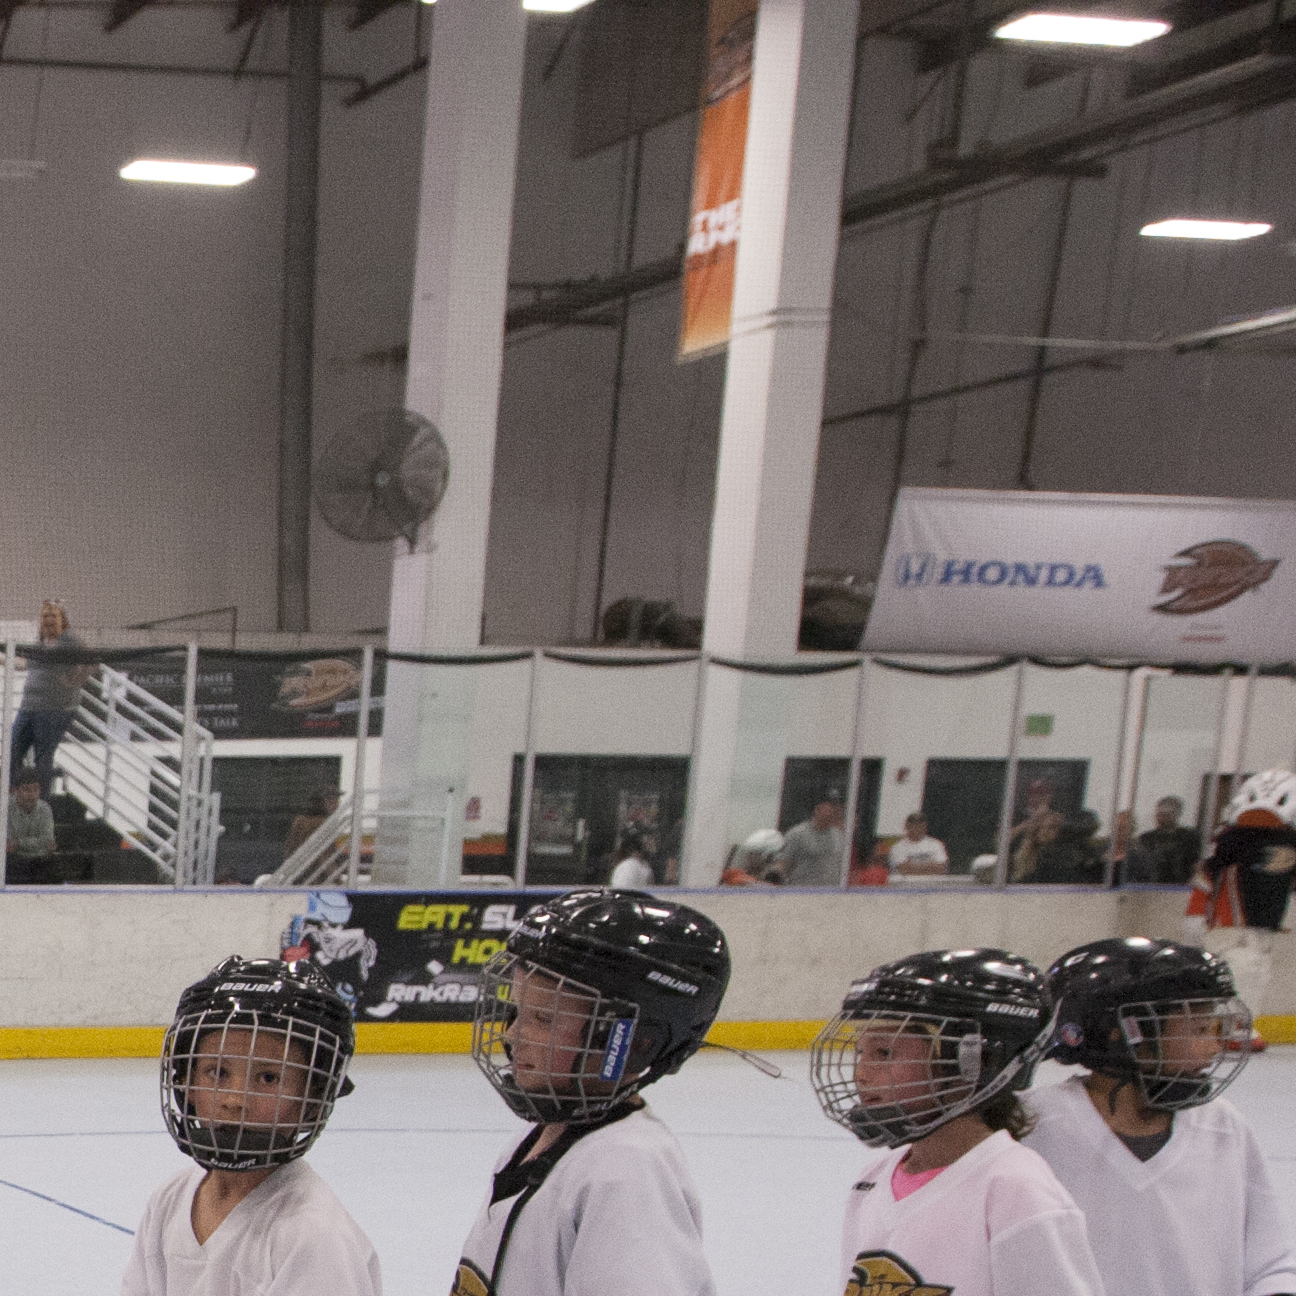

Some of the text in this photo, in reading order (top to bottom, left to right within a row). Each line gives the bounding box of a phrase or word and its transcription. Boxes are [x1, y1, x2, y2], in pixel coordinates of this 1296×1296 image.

[939, 559, 1107, 589] HONDA
[219, 982, 282, 994] BAUER
[646, 970, 699, 995] BAUER
[986, 1002, 1040, 1018] BAUER
[603, 1022, 627, 1078] BAUER
